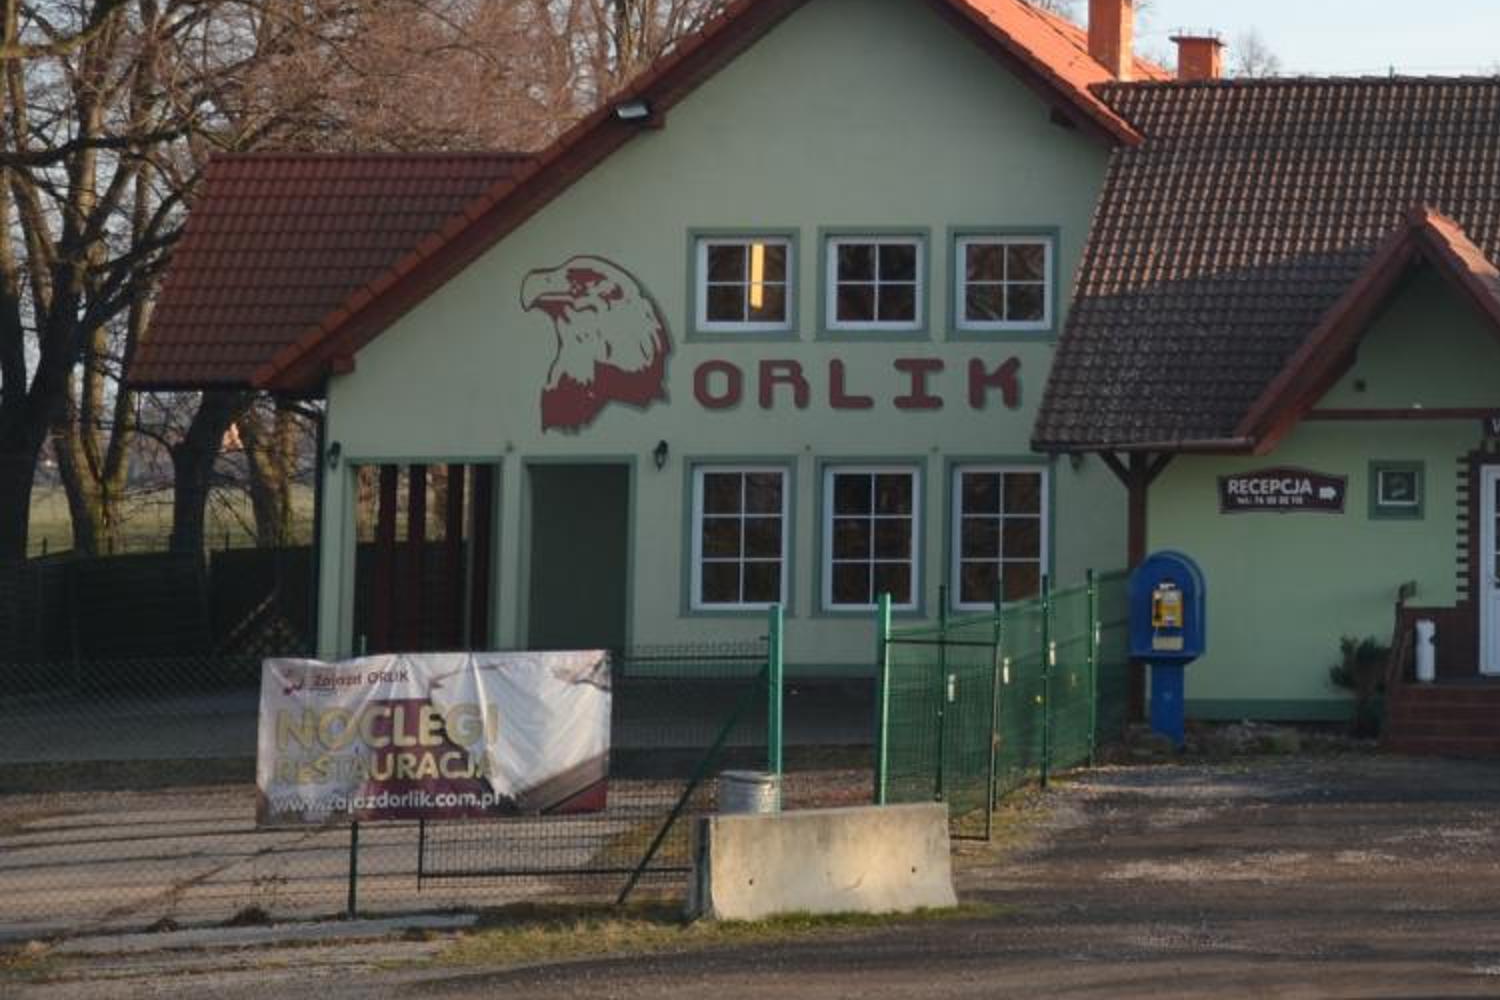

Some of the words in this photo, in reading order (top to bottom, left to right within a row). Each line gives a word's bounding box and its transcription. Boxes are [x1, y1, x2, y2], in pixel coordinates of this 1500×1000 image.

[693, 357, 1022, 410] ORLIK
[1228, 479, 1313, 495] RECEPCJA
[276, 702, 498, 751] NOCLEGI
[274, 752, 489, 785] RESTAURACJA
